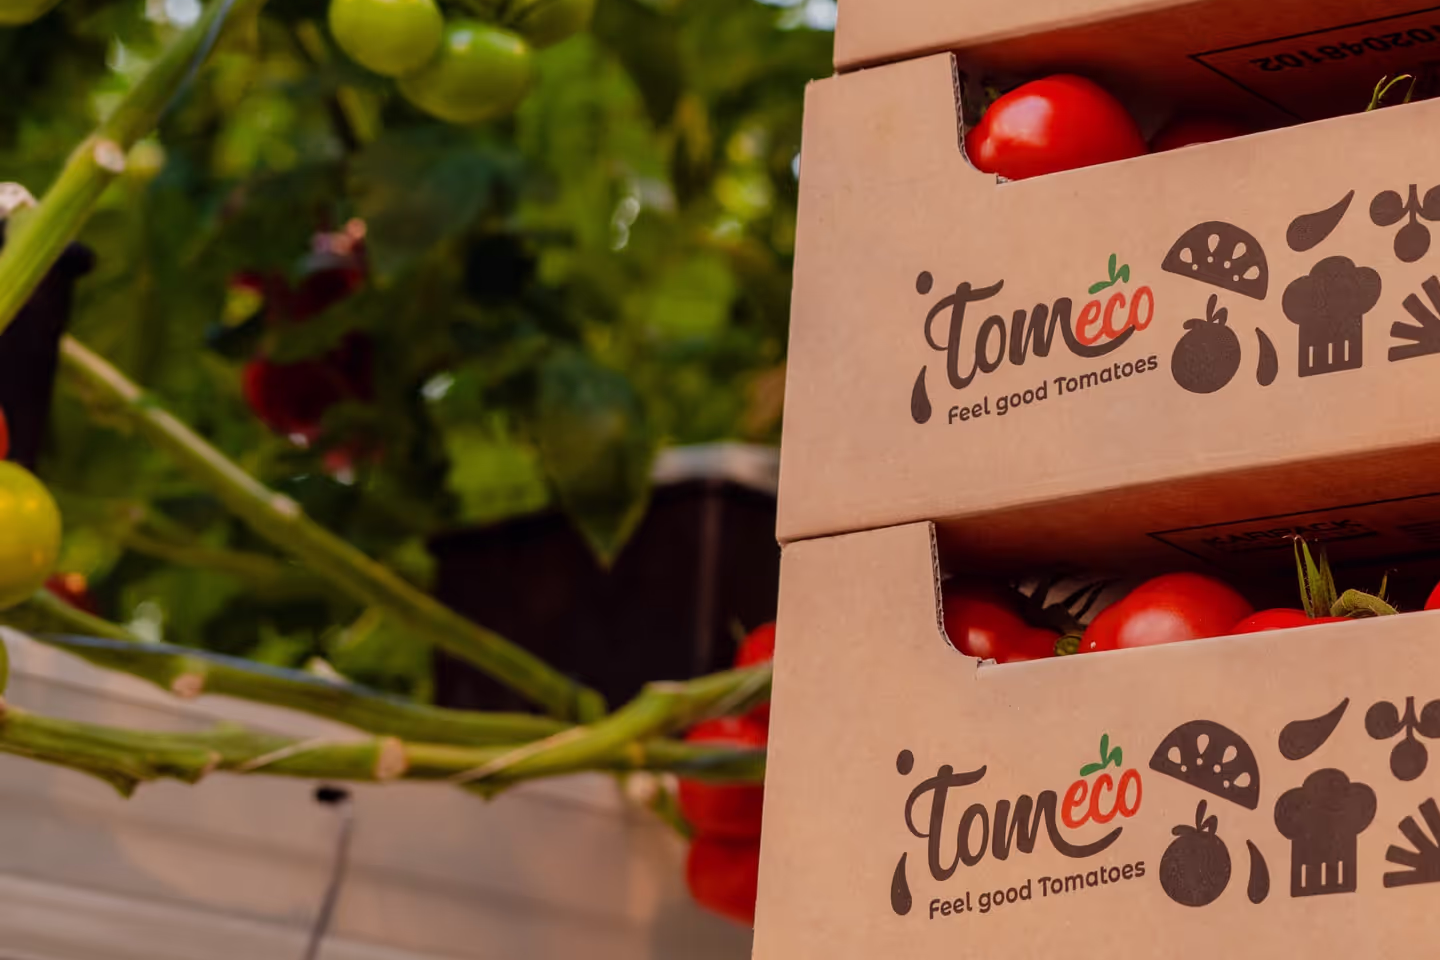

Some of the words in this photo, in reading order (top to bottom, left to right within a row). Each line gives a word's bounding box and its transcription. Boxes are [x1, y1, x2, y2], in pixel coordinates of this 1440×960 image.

[924, 279, 1155, 390] Tomeco
[948, 396, 991, 425] Feel
[996, 380, 1048, 416] good
[1053, 354, 1159, 396] Tomatoes
[904, 764, 1143, 882] Tomeco
[929, 892, 973, 920] Feel
[978, 878, 1032, 914] good
[1037, 860, 1146, 897] Tomatoes
